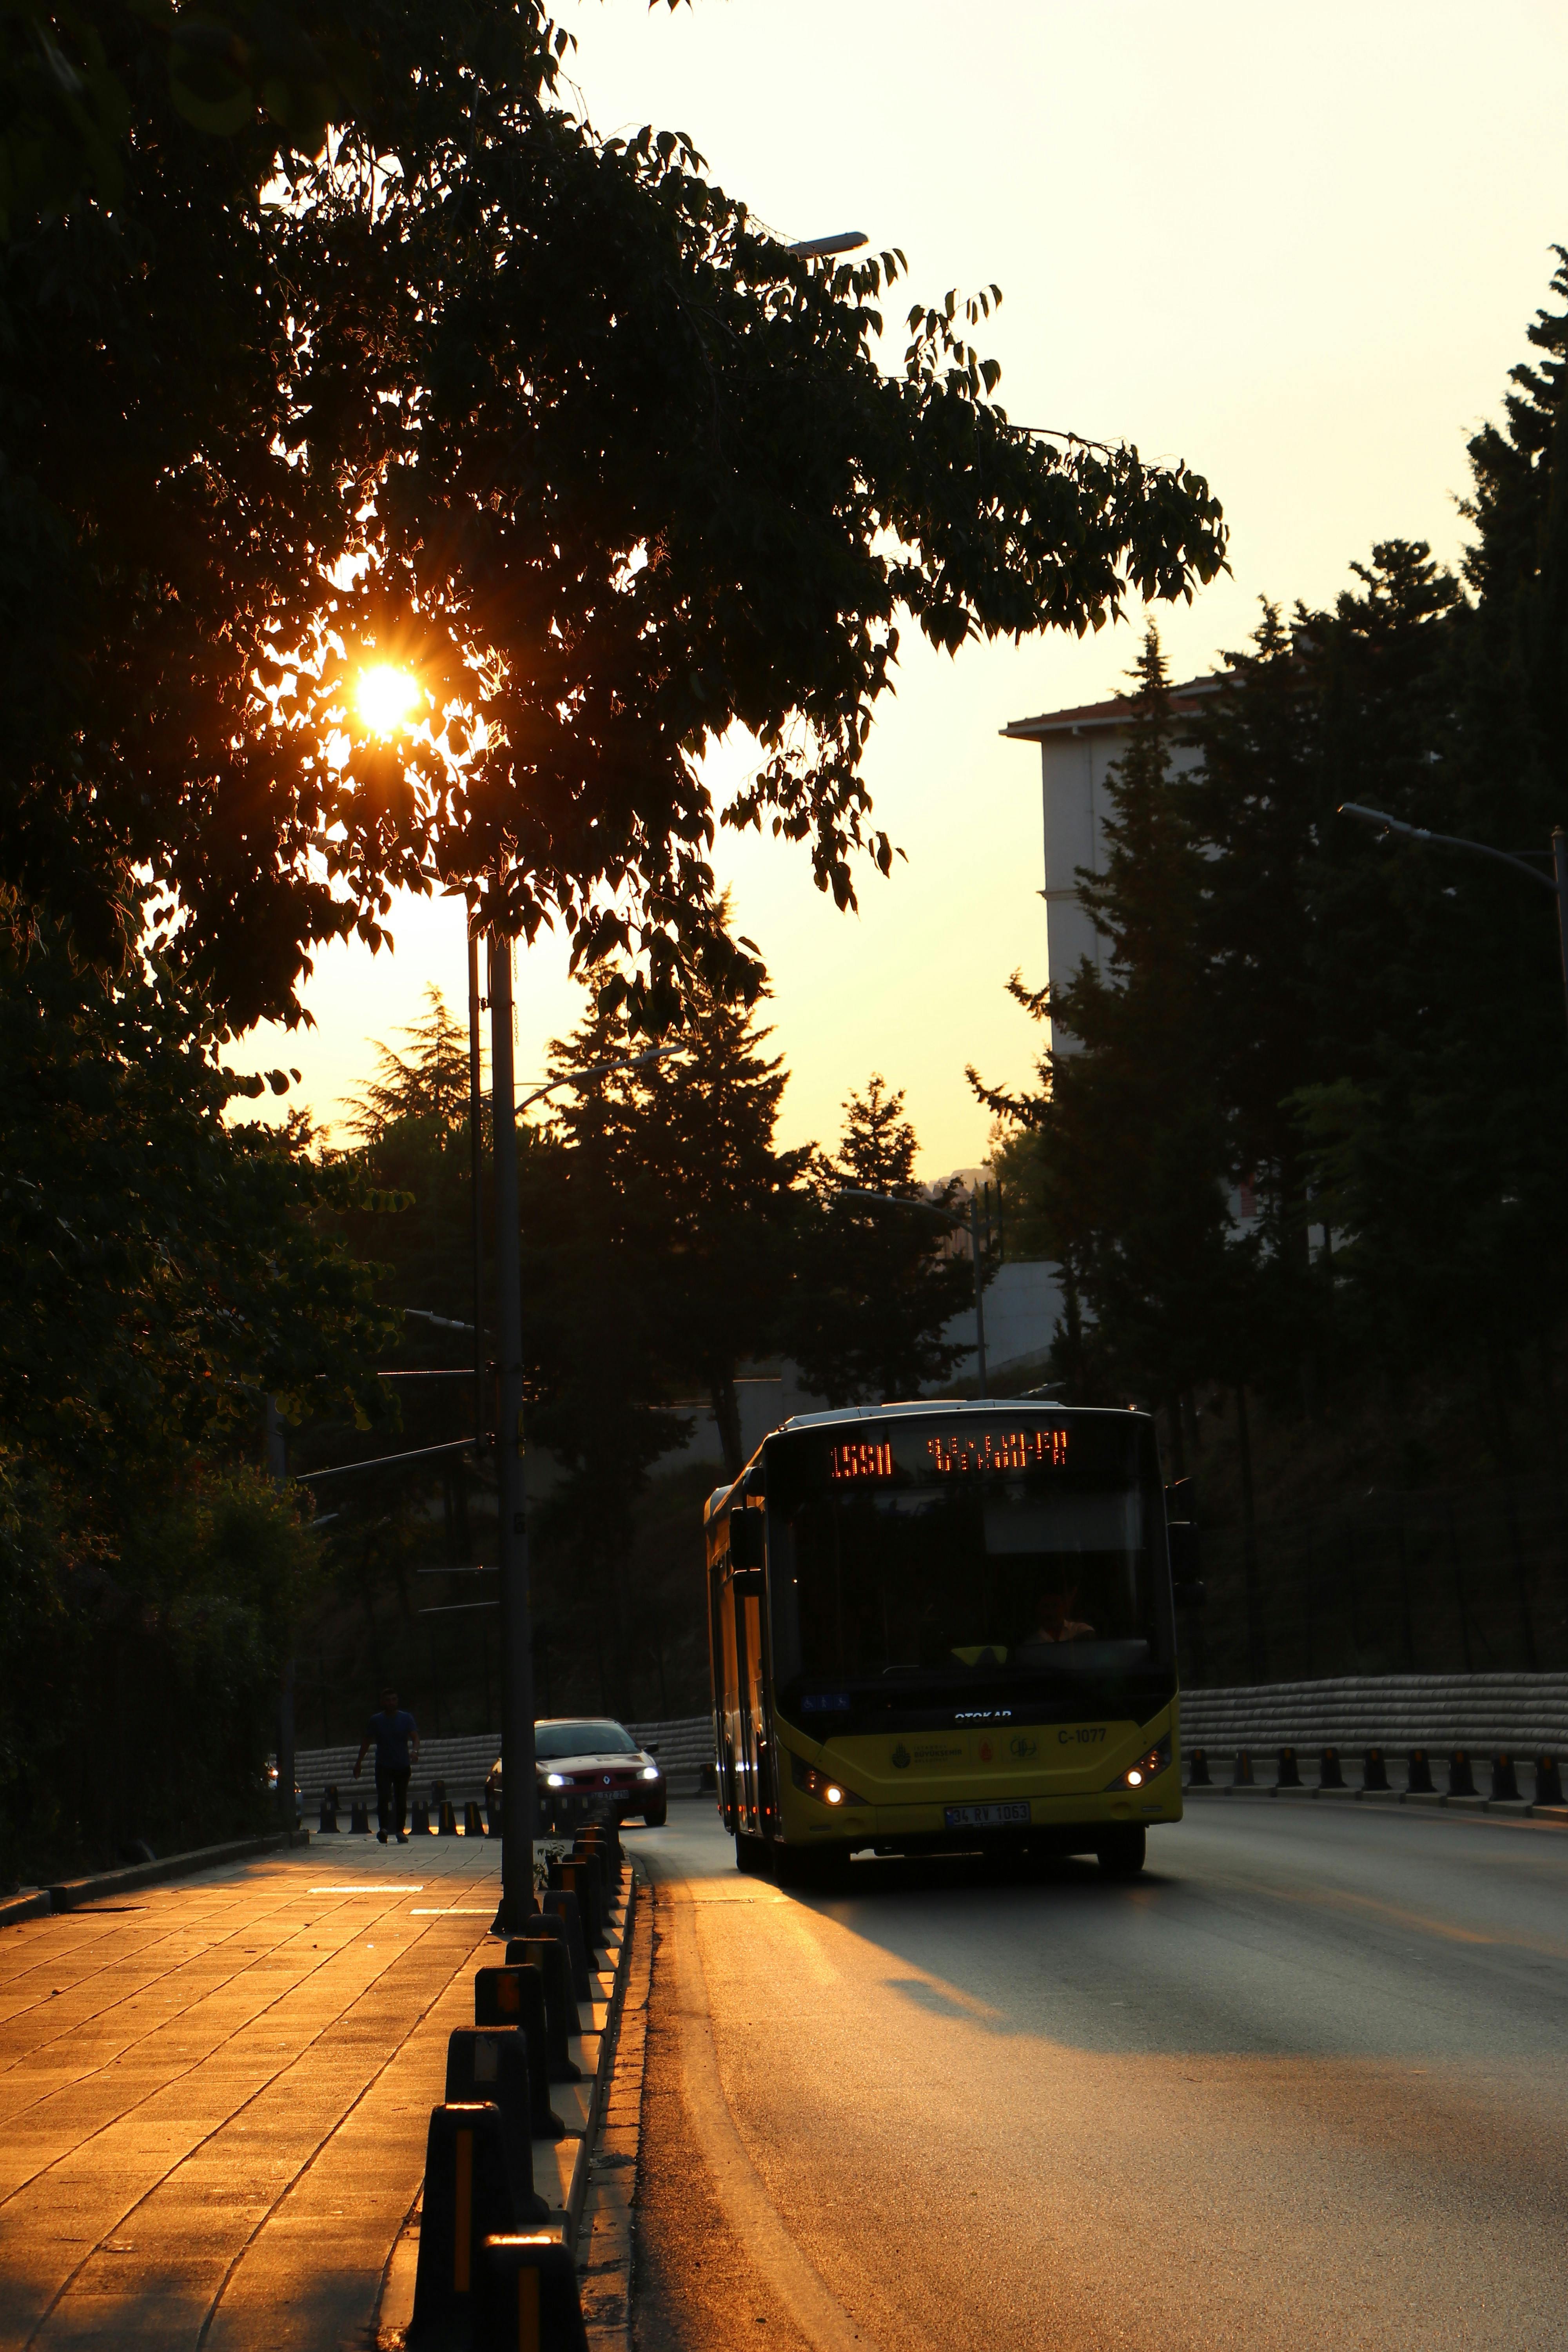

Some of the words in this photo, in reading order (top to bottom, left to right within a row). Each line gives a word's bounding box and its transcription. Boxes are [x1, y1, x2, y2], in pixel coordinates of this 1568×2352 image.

[955, 1710, 1012, 1723] OTOKAR
[1058, 1728, 1106, 1744] C-1077
[953, 1809, 969, 1822] 34
[975, 1808, 989, 1822] RV
[997, 1805, 1027, 1820] 1063
